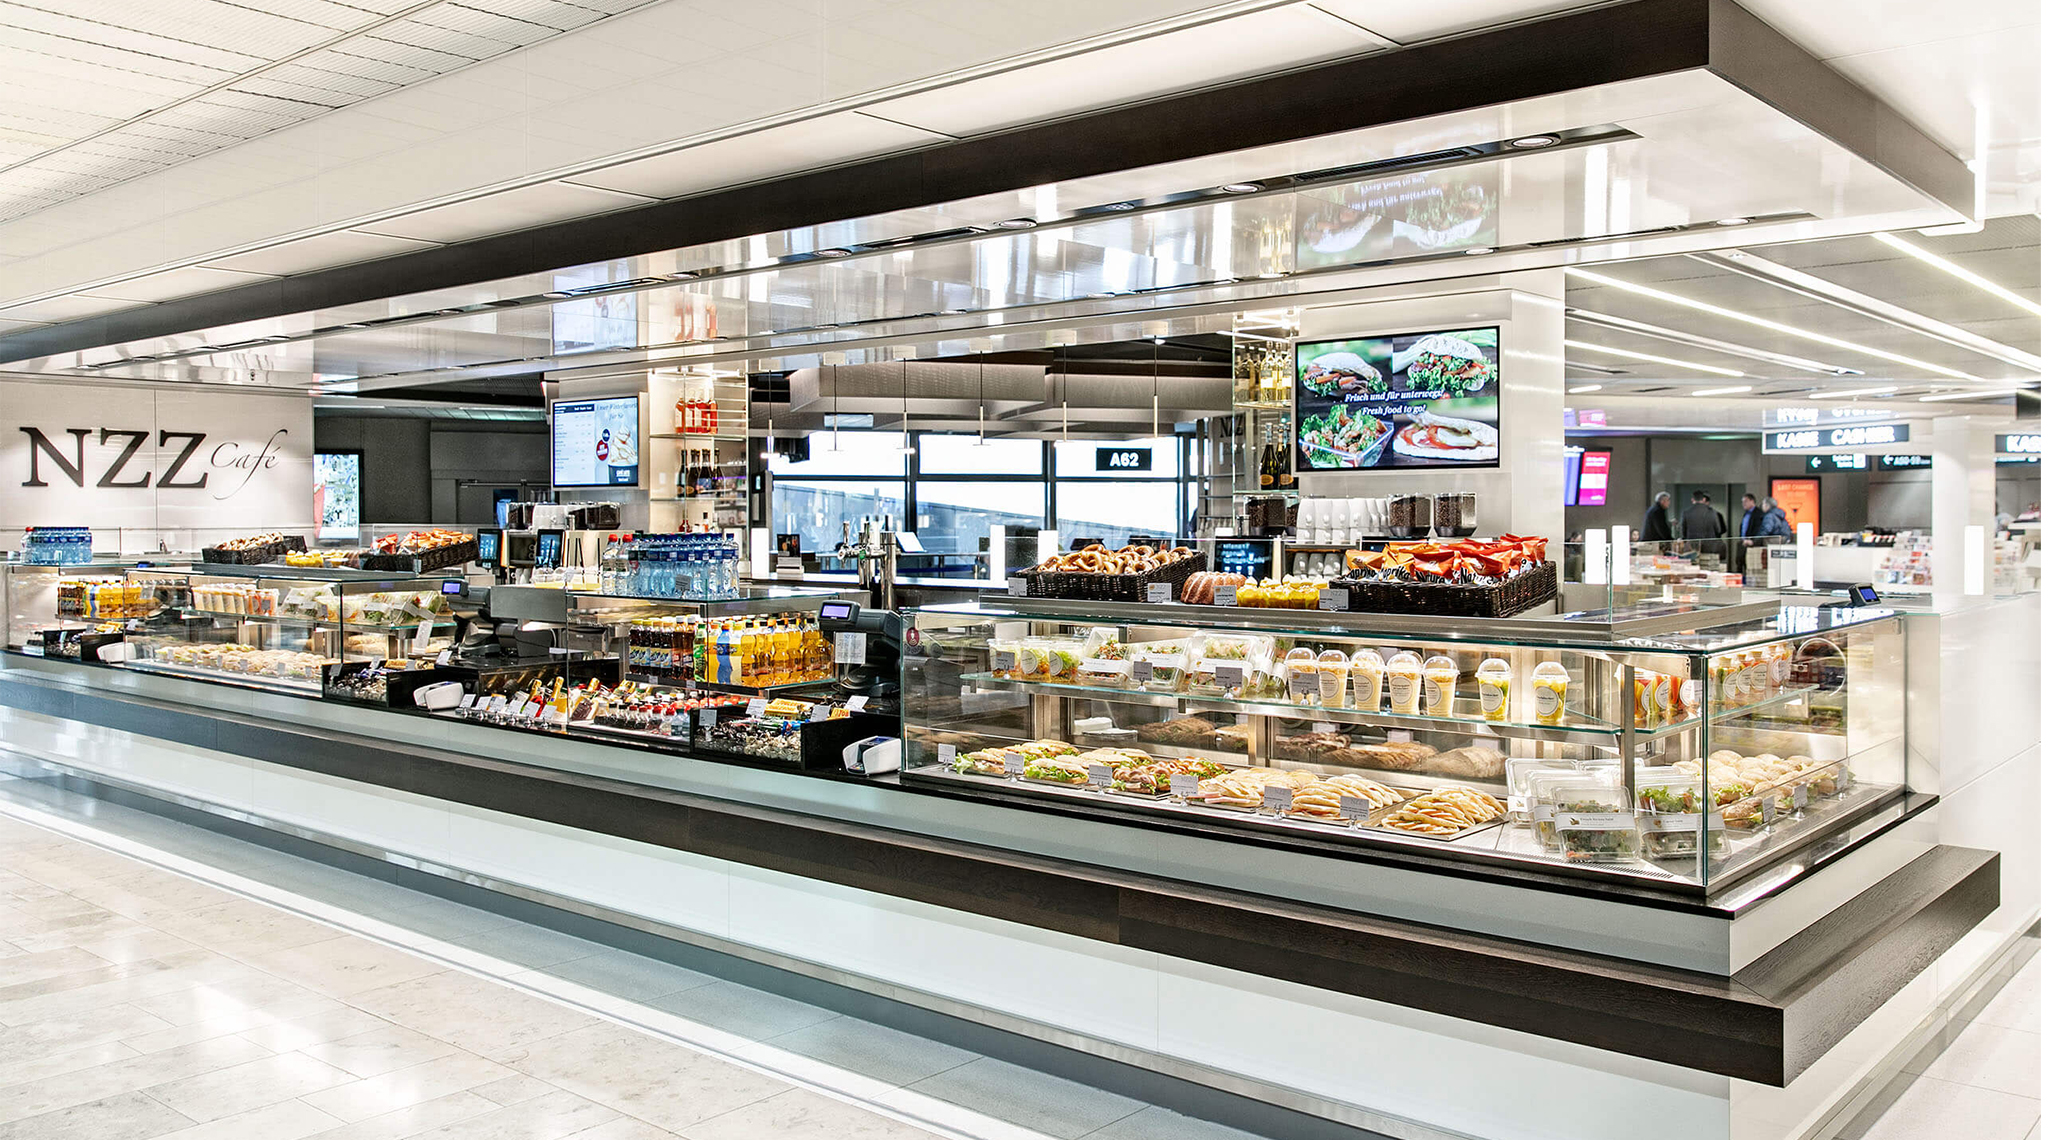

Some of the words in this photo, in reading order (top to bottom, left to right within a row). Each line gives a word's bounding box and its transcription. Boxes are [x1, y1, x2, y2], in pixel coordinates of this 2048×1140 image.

[1345, 393, 1369, 402] Frisch
[1370, 391, 1385, 401] und
[1385, 391, 1400, 403] für
[1400, 389, 1444, 400] unterwegs!
[1362, 406, 1383, 416] Fresh
[1383, 405, 1402, 416] food
[1403, 404, 1412, 413] to
[1413, 404, 1426, 415] go!
[19, 427, 208, 488] NZZ
[210, 429, 288, 500] Café
[1109, 452, 1139, 467] A62
